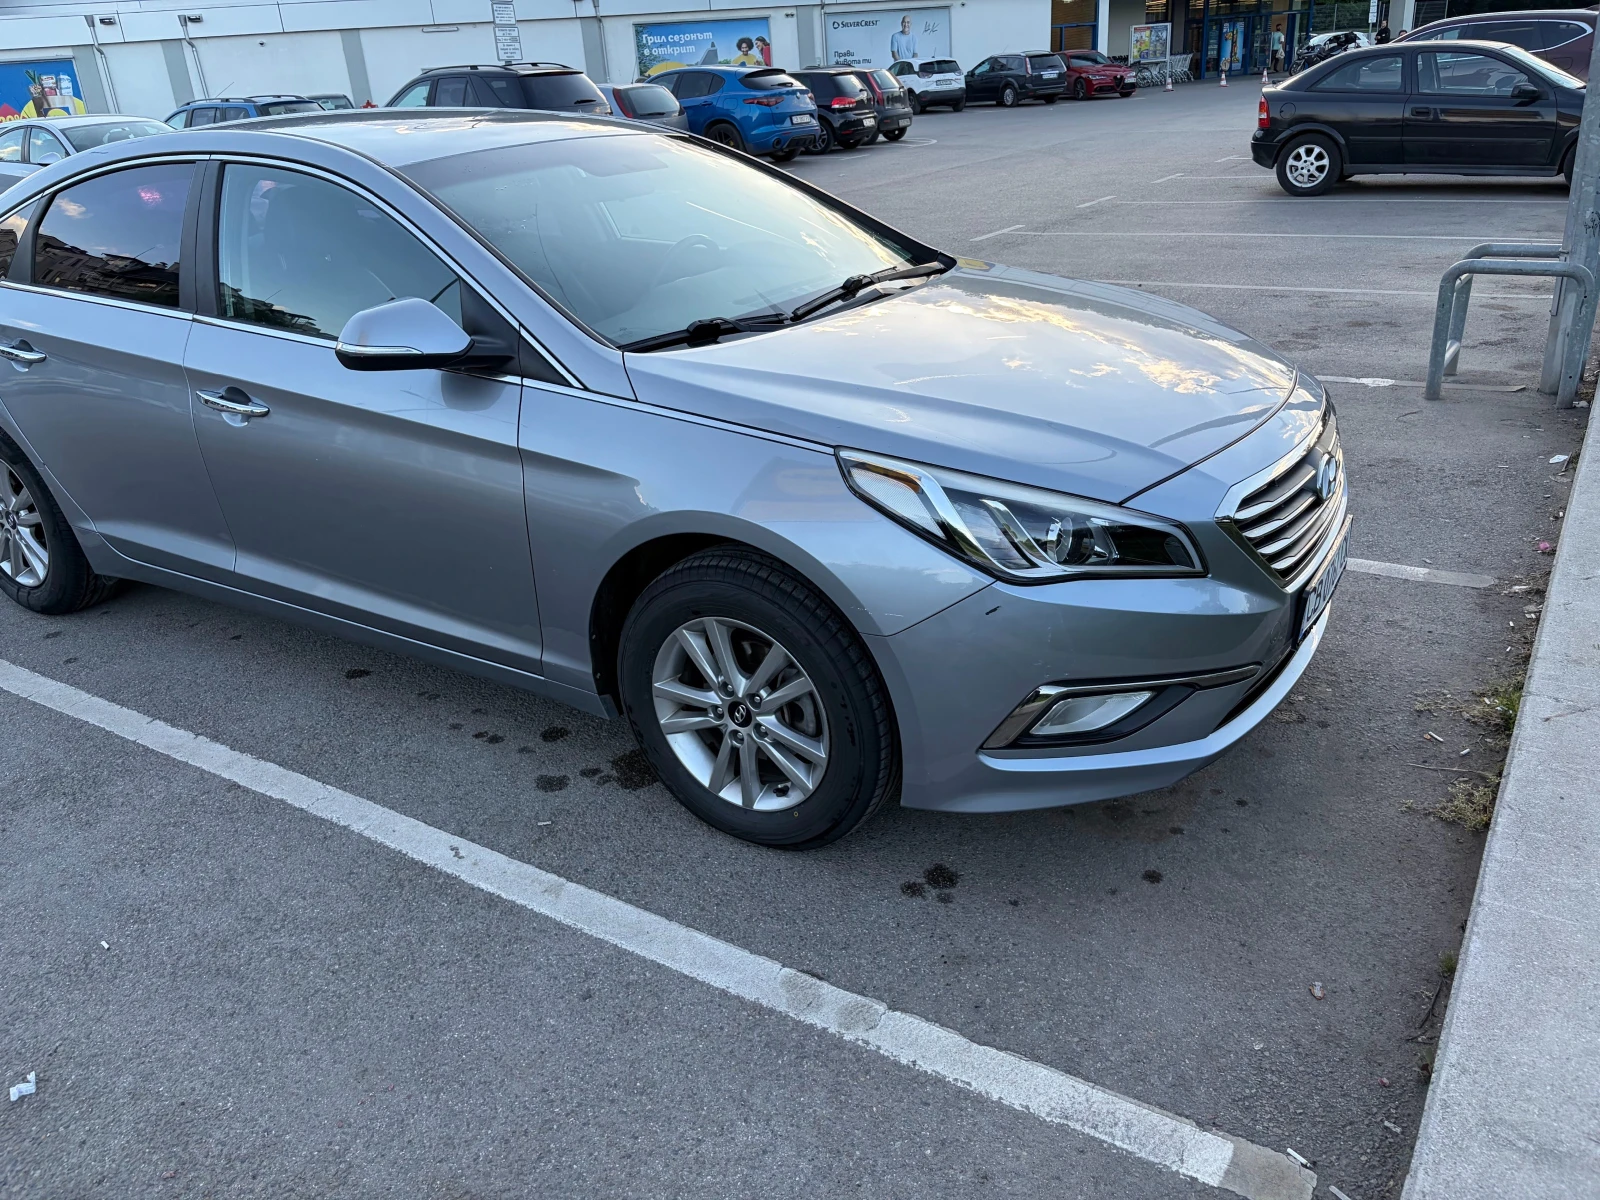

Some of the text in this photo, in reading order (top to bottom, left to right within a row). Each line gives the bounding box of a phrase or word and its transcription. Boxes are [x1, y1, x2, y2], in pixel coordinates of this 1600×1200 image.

[642, 32, 713, 45] Грил сезонът
[652, 45, 695, 56] открит
[834, 49, 855, 59] Прави
